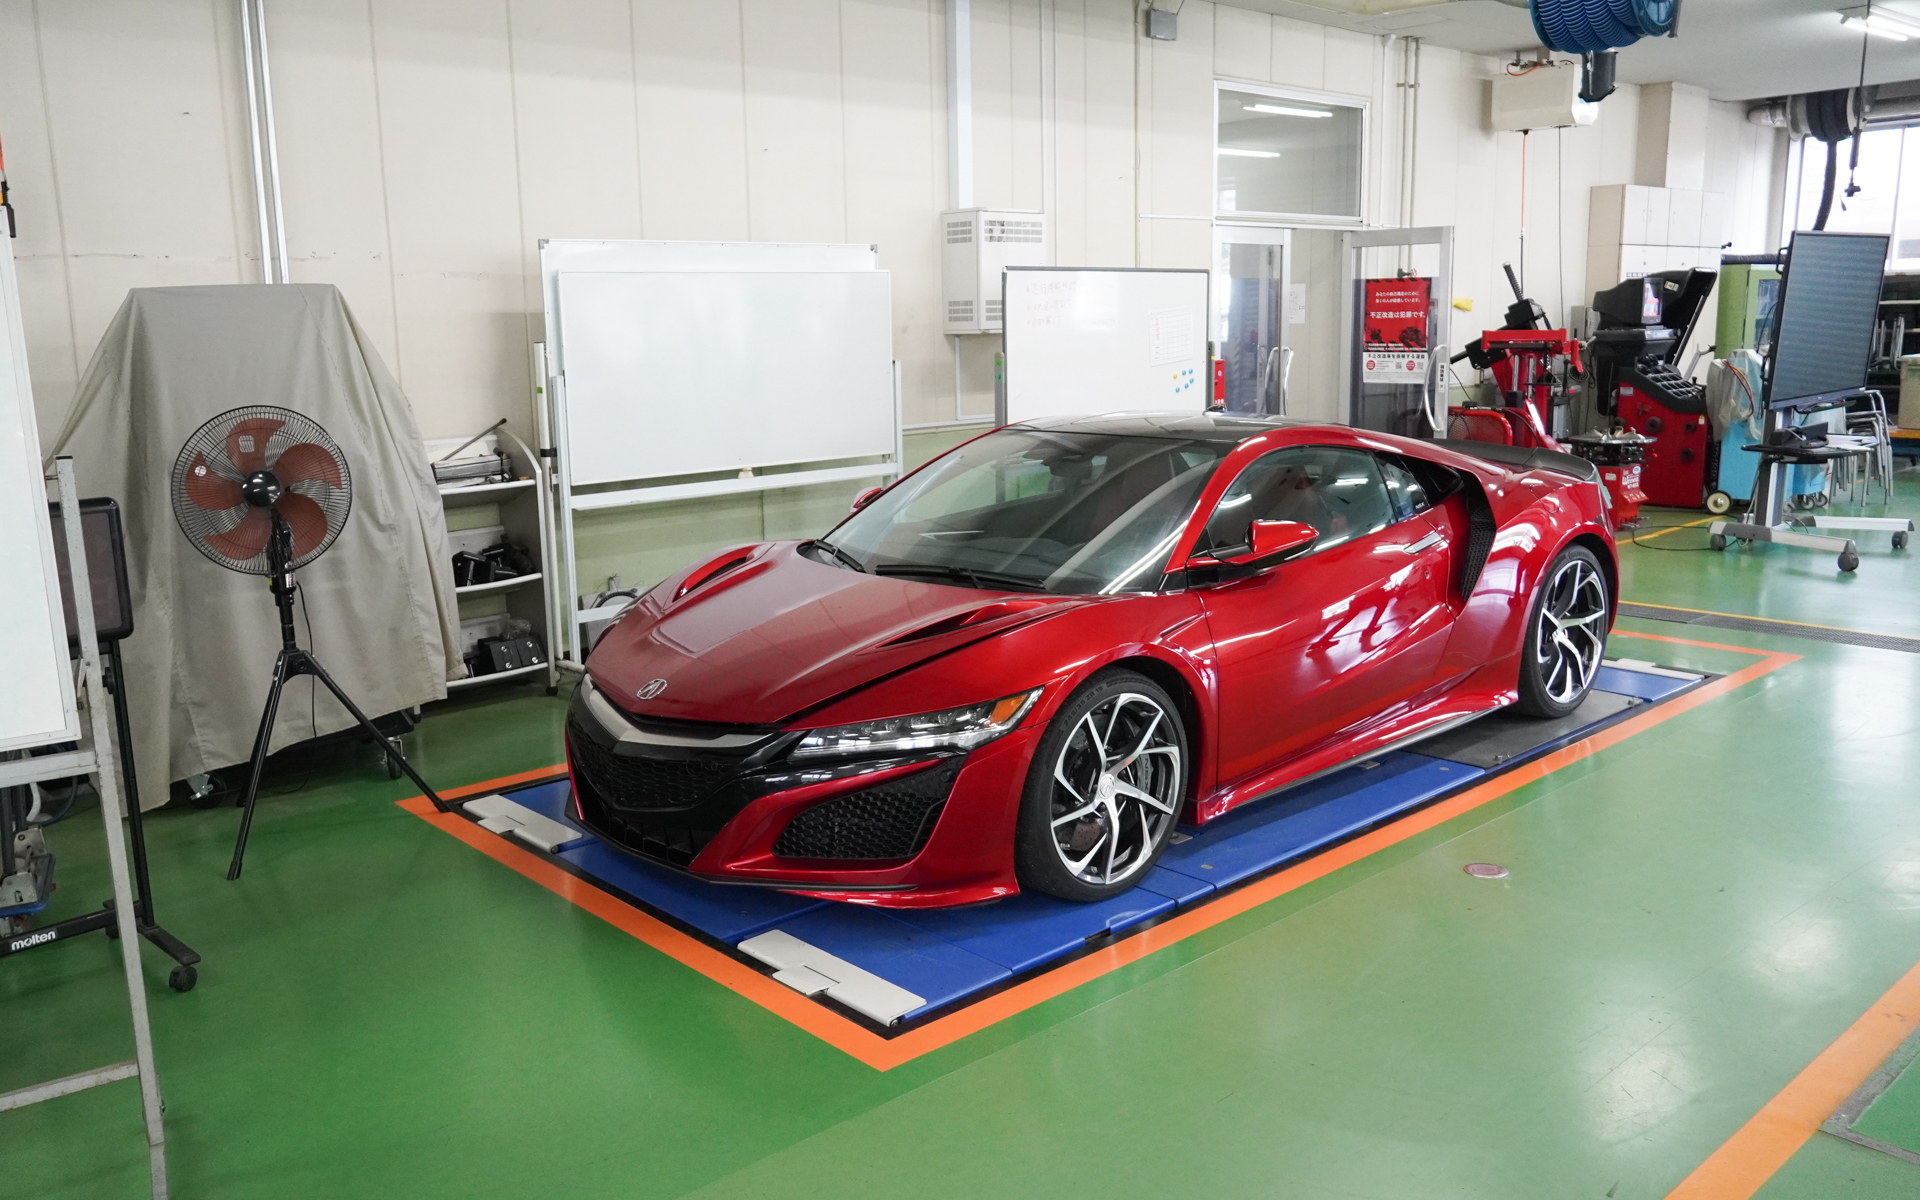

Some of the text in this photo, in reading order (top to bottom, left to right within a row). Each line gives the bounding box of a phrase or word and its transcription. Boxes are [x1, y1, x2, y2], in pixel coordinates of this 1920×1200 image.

[1063, 700, 1086, 727] 245/35
[1085, 691, 1095, 700] ZR
[11, 931, 55, 951] molten
